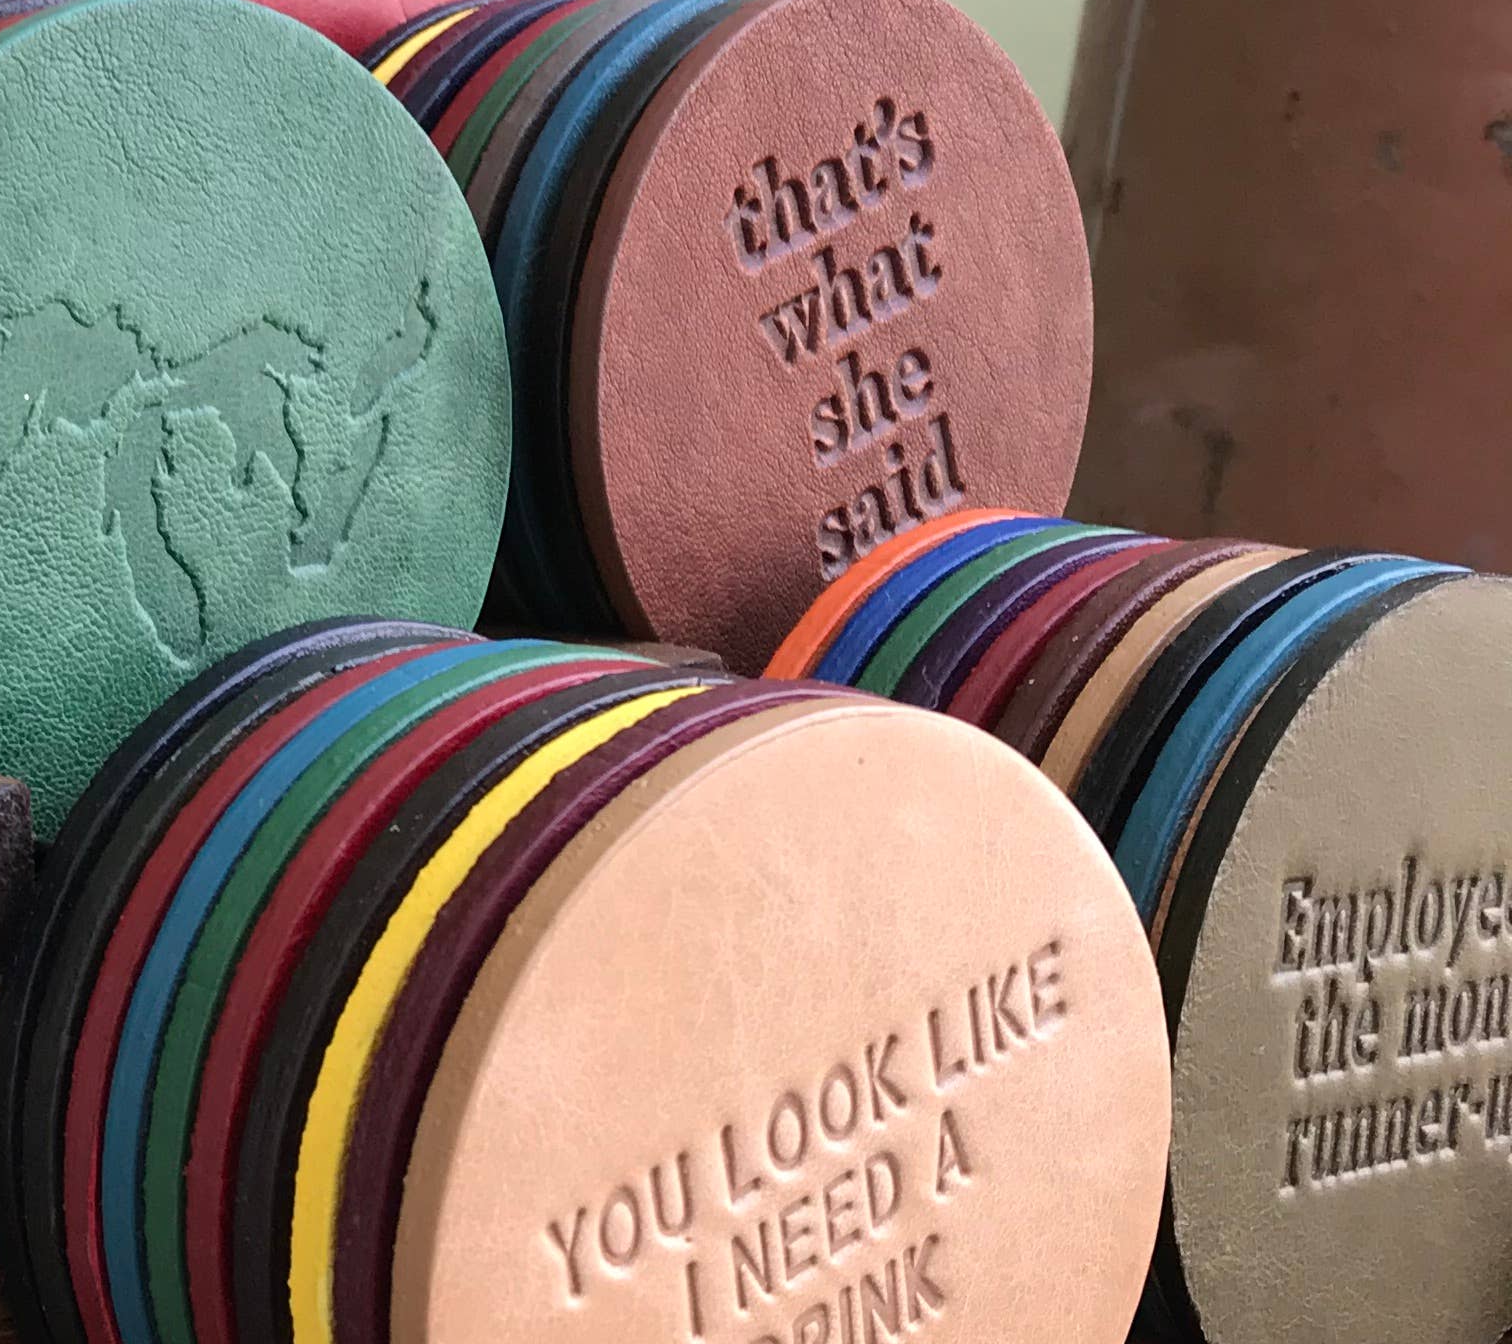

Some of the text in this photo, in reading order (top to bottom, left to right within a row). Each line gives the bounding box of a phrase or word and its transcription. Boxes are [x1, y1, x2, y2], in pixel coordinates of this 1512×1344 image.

[724, 96, 936, 275] that's
[759, 211, 943, 367] what
[811, 346, 935, 468] she
[816, 411, 966, 581] said
[1278, 853, 1512, 990] Employe
[1292, 978, 1380, 1084] the
[545, 939, 1069, 1302] YOU LOOK LIKE
[684, 1107, 973, 1341] I NEED A
